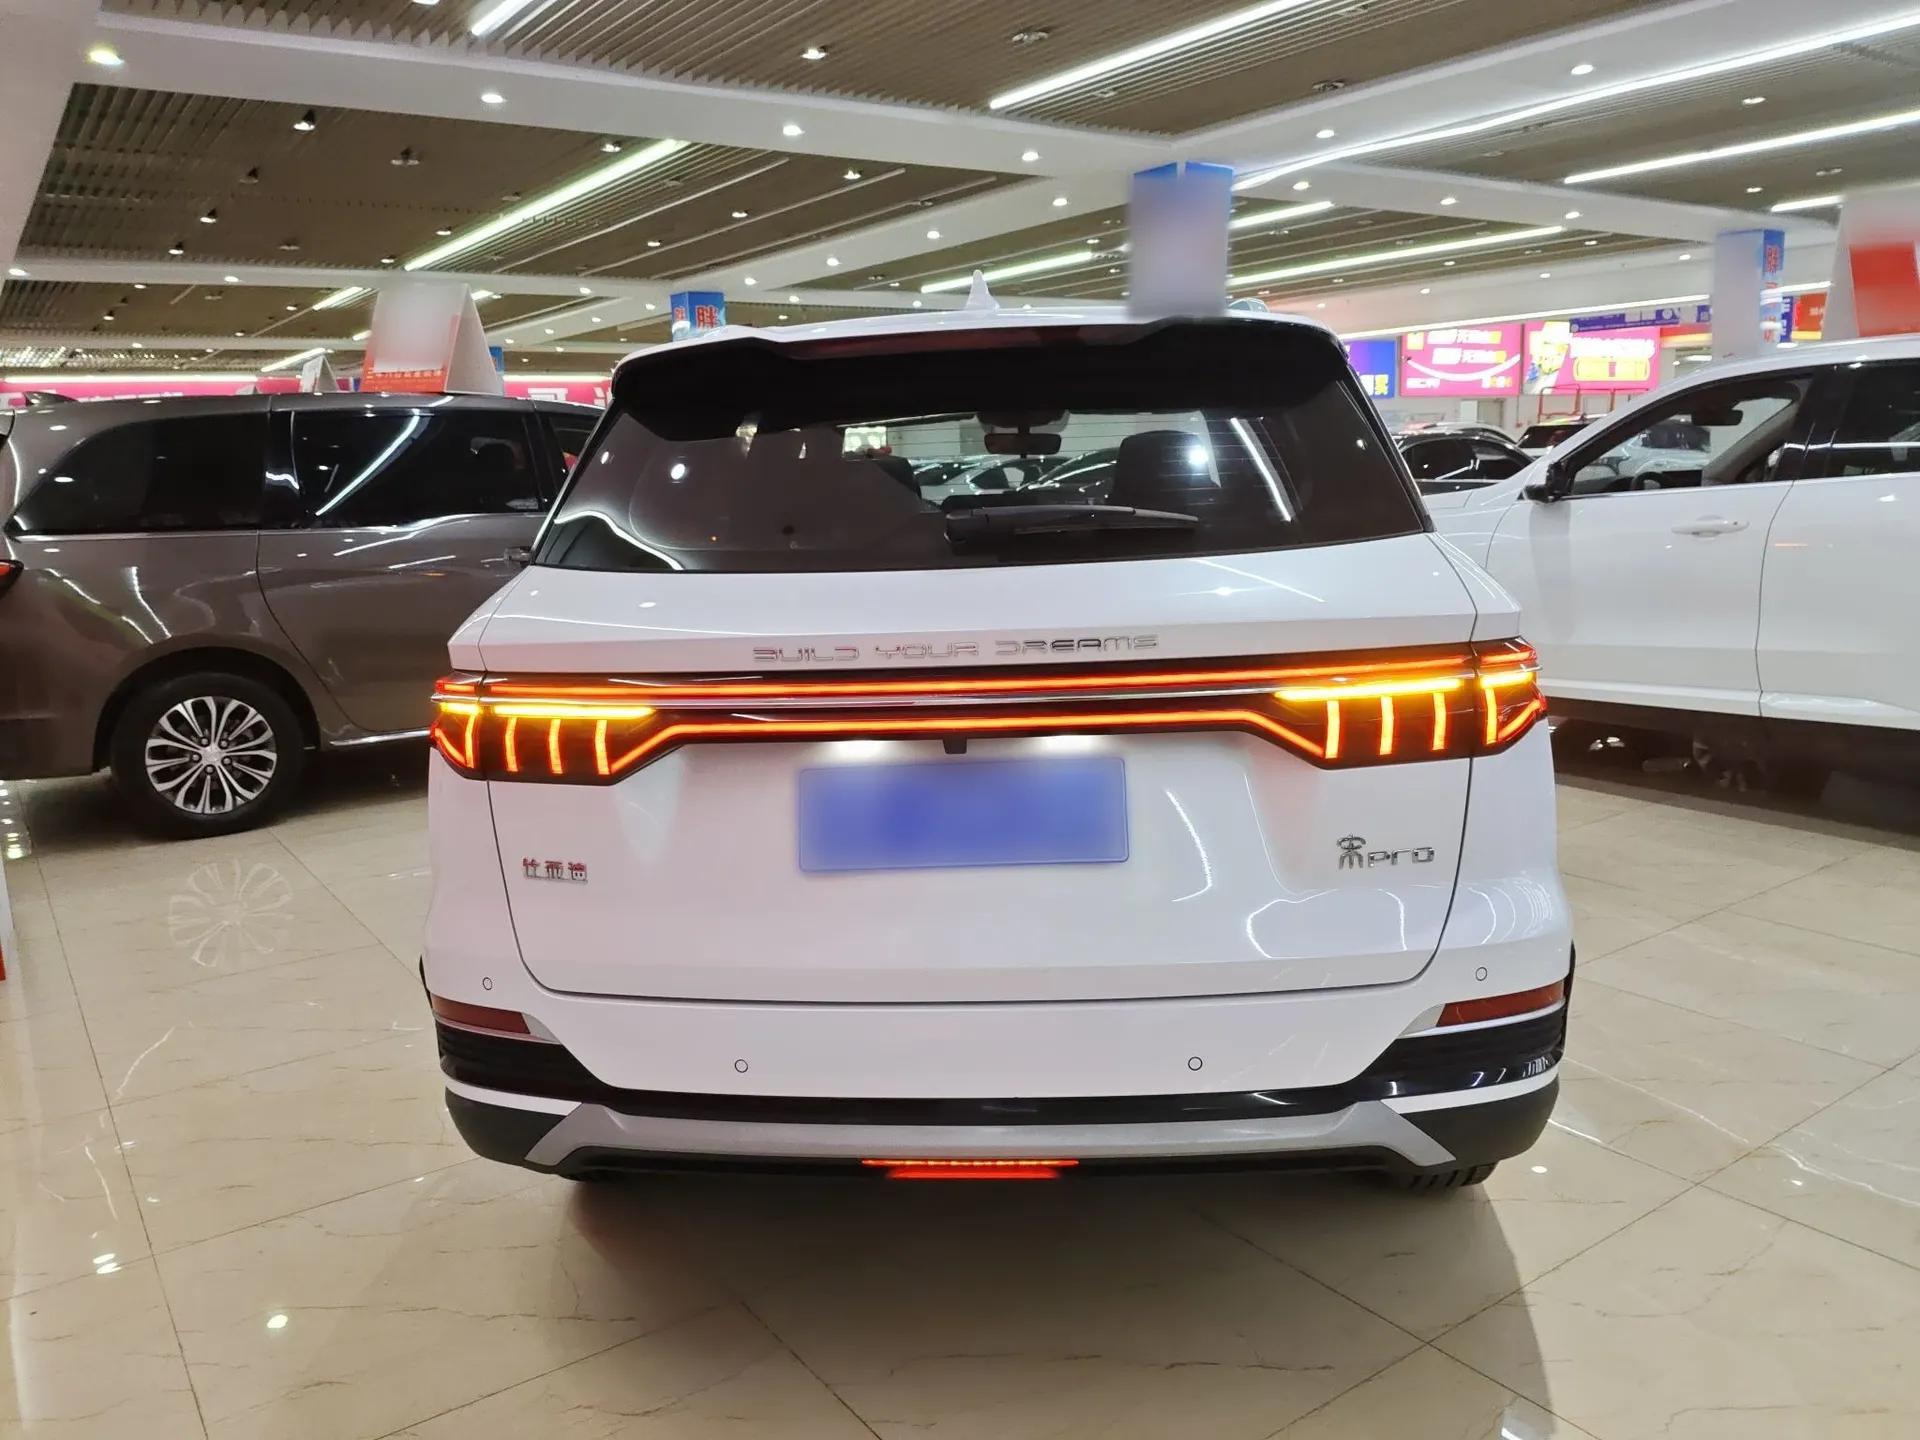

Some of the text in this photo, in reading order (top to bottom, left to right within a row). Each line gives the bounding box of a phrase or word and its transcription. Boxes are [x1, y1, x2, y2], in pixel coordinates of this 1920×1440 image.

[752, 634, 1159, 662] BUILD YOUR DREAMS
